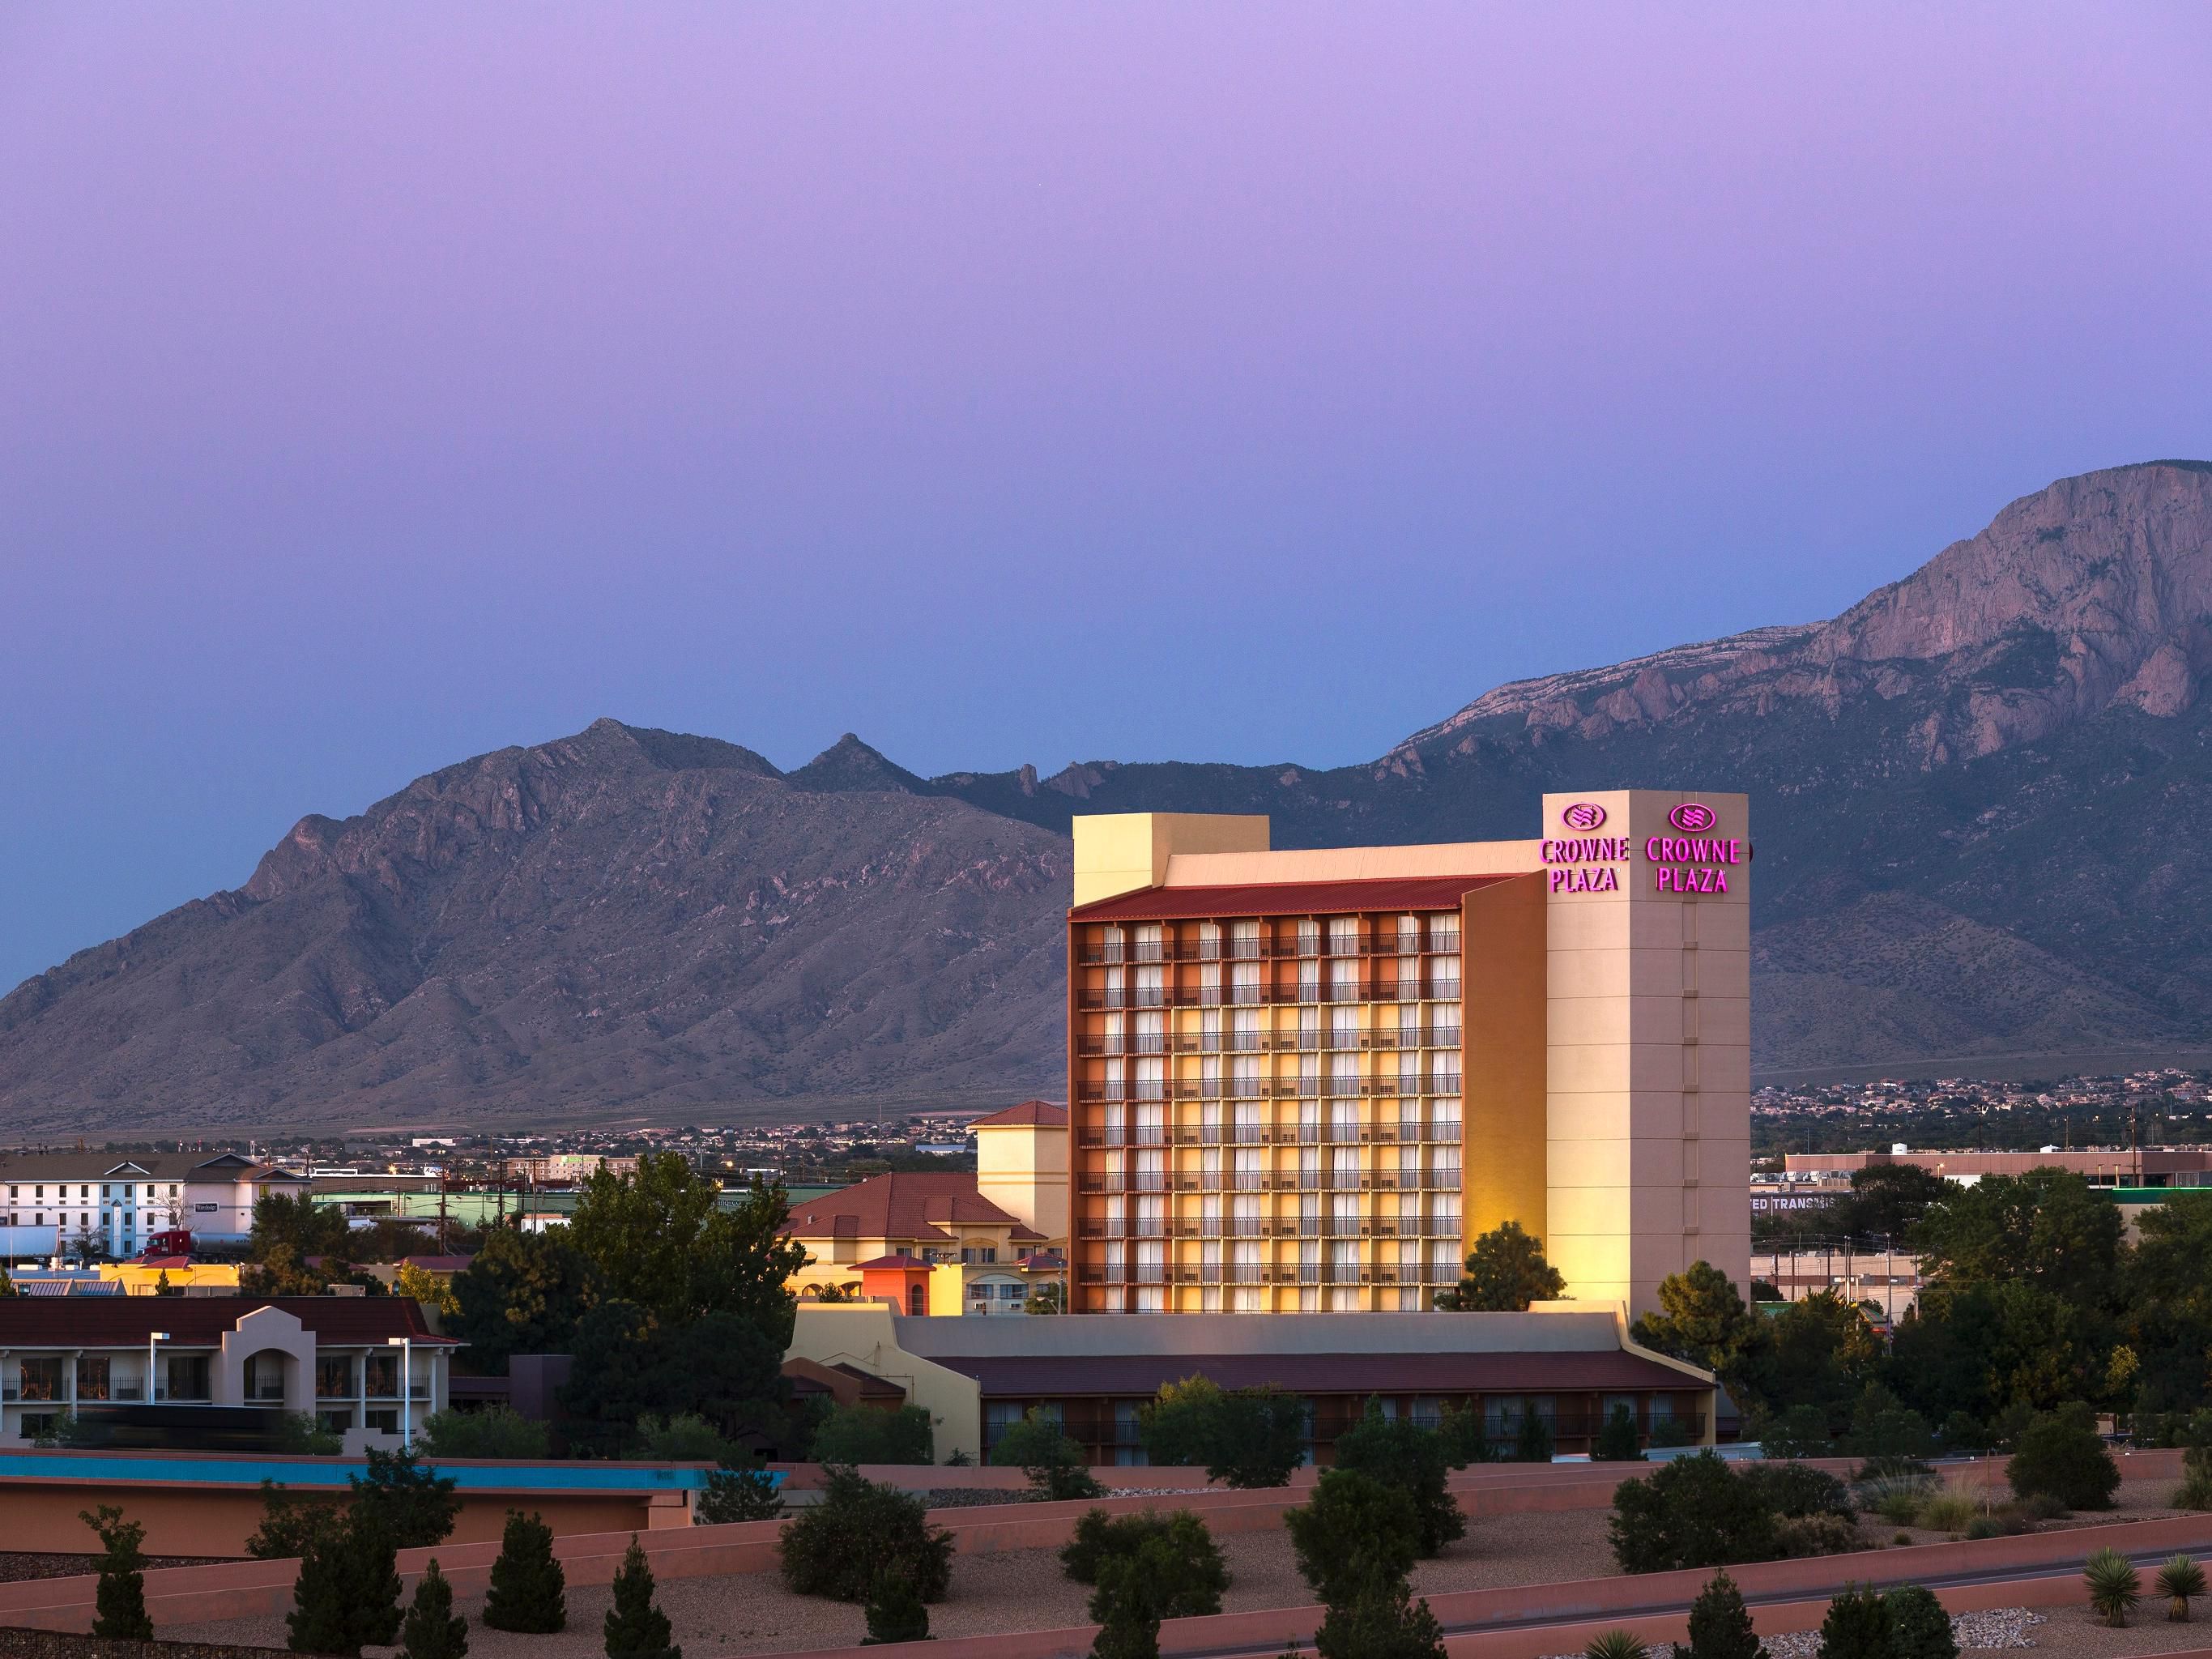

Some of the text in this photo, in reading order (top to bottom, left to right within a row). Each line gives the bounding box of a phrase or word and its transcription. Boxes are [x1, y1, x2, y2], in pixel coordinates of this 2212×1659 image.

[1540, 838, 1628, 863] CROWNE
[1646, 837, 1741, 864] CROWNE
[1550, 868, 1618, 893] PLAZA
[1657, 868, 1728, 893] PLAZA
[1750, 1199, 1768, 1209] ED
